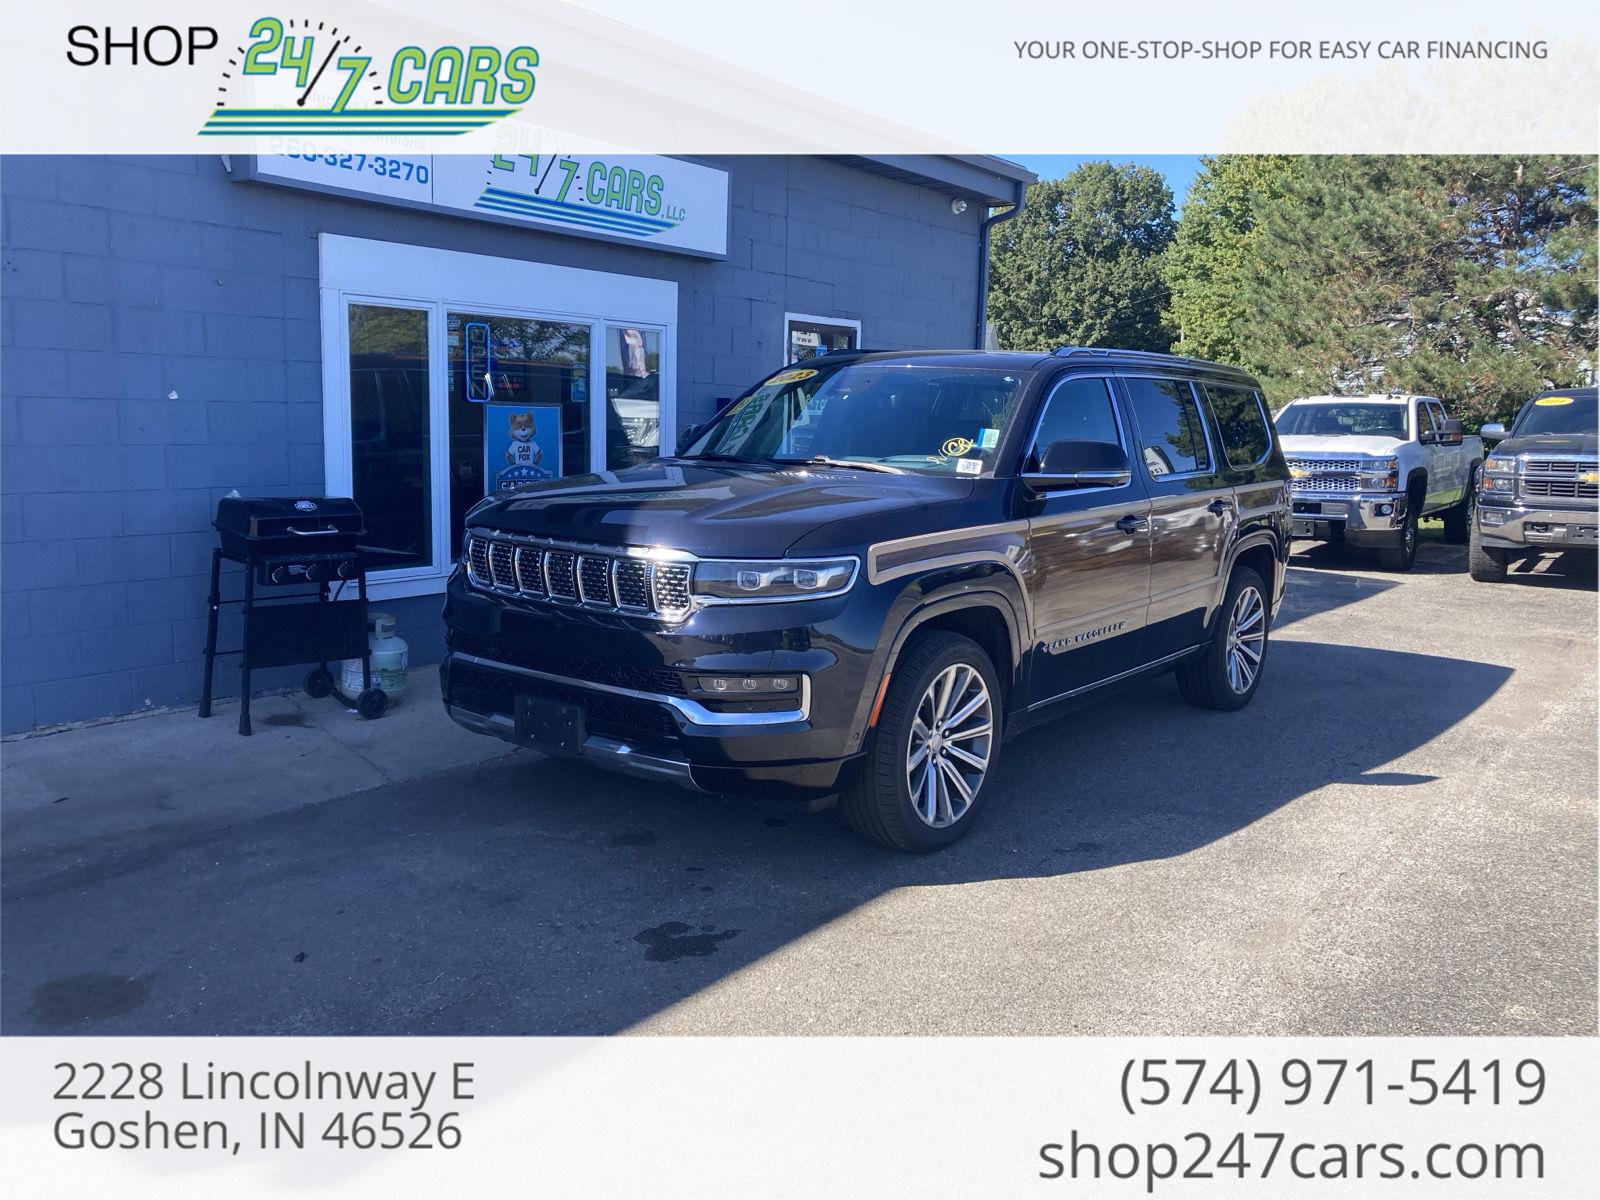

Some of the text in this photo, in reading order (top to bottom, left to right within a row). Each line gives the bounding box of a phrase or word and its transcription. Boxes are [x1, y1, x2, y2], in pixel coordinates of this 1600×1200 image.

[517, 445, 531, 454] CAR
[518, 453, 531, 462] FOX
[1042, 637, 1072, 653] GRAND
